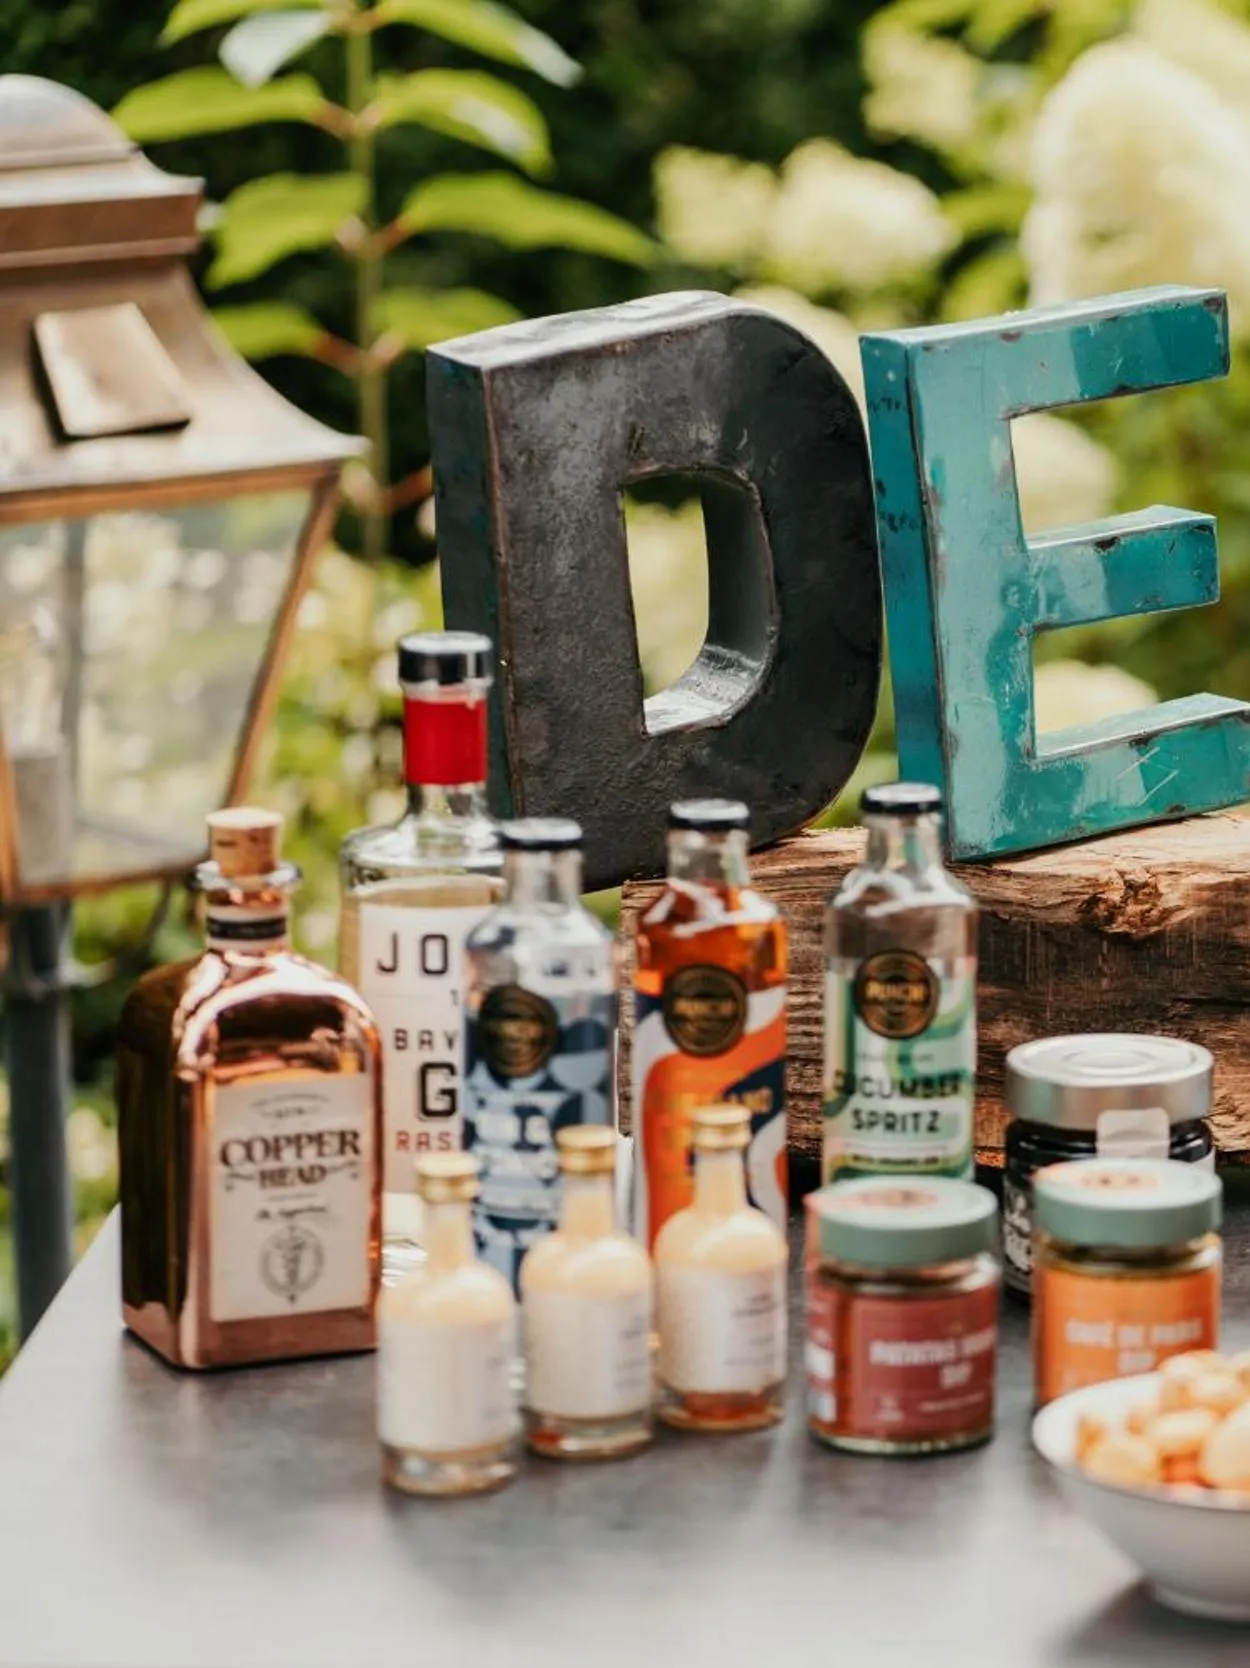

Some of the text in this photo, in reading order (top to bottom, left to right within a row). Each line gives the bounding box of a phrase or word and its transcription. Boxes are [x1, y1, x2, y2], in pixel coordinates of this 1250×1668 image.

[852, 1108, 940, 1133] SPRITZ
[220, 1130, 361, 1166] COPPER
[260, 1165, 327, 1189] HEAD
